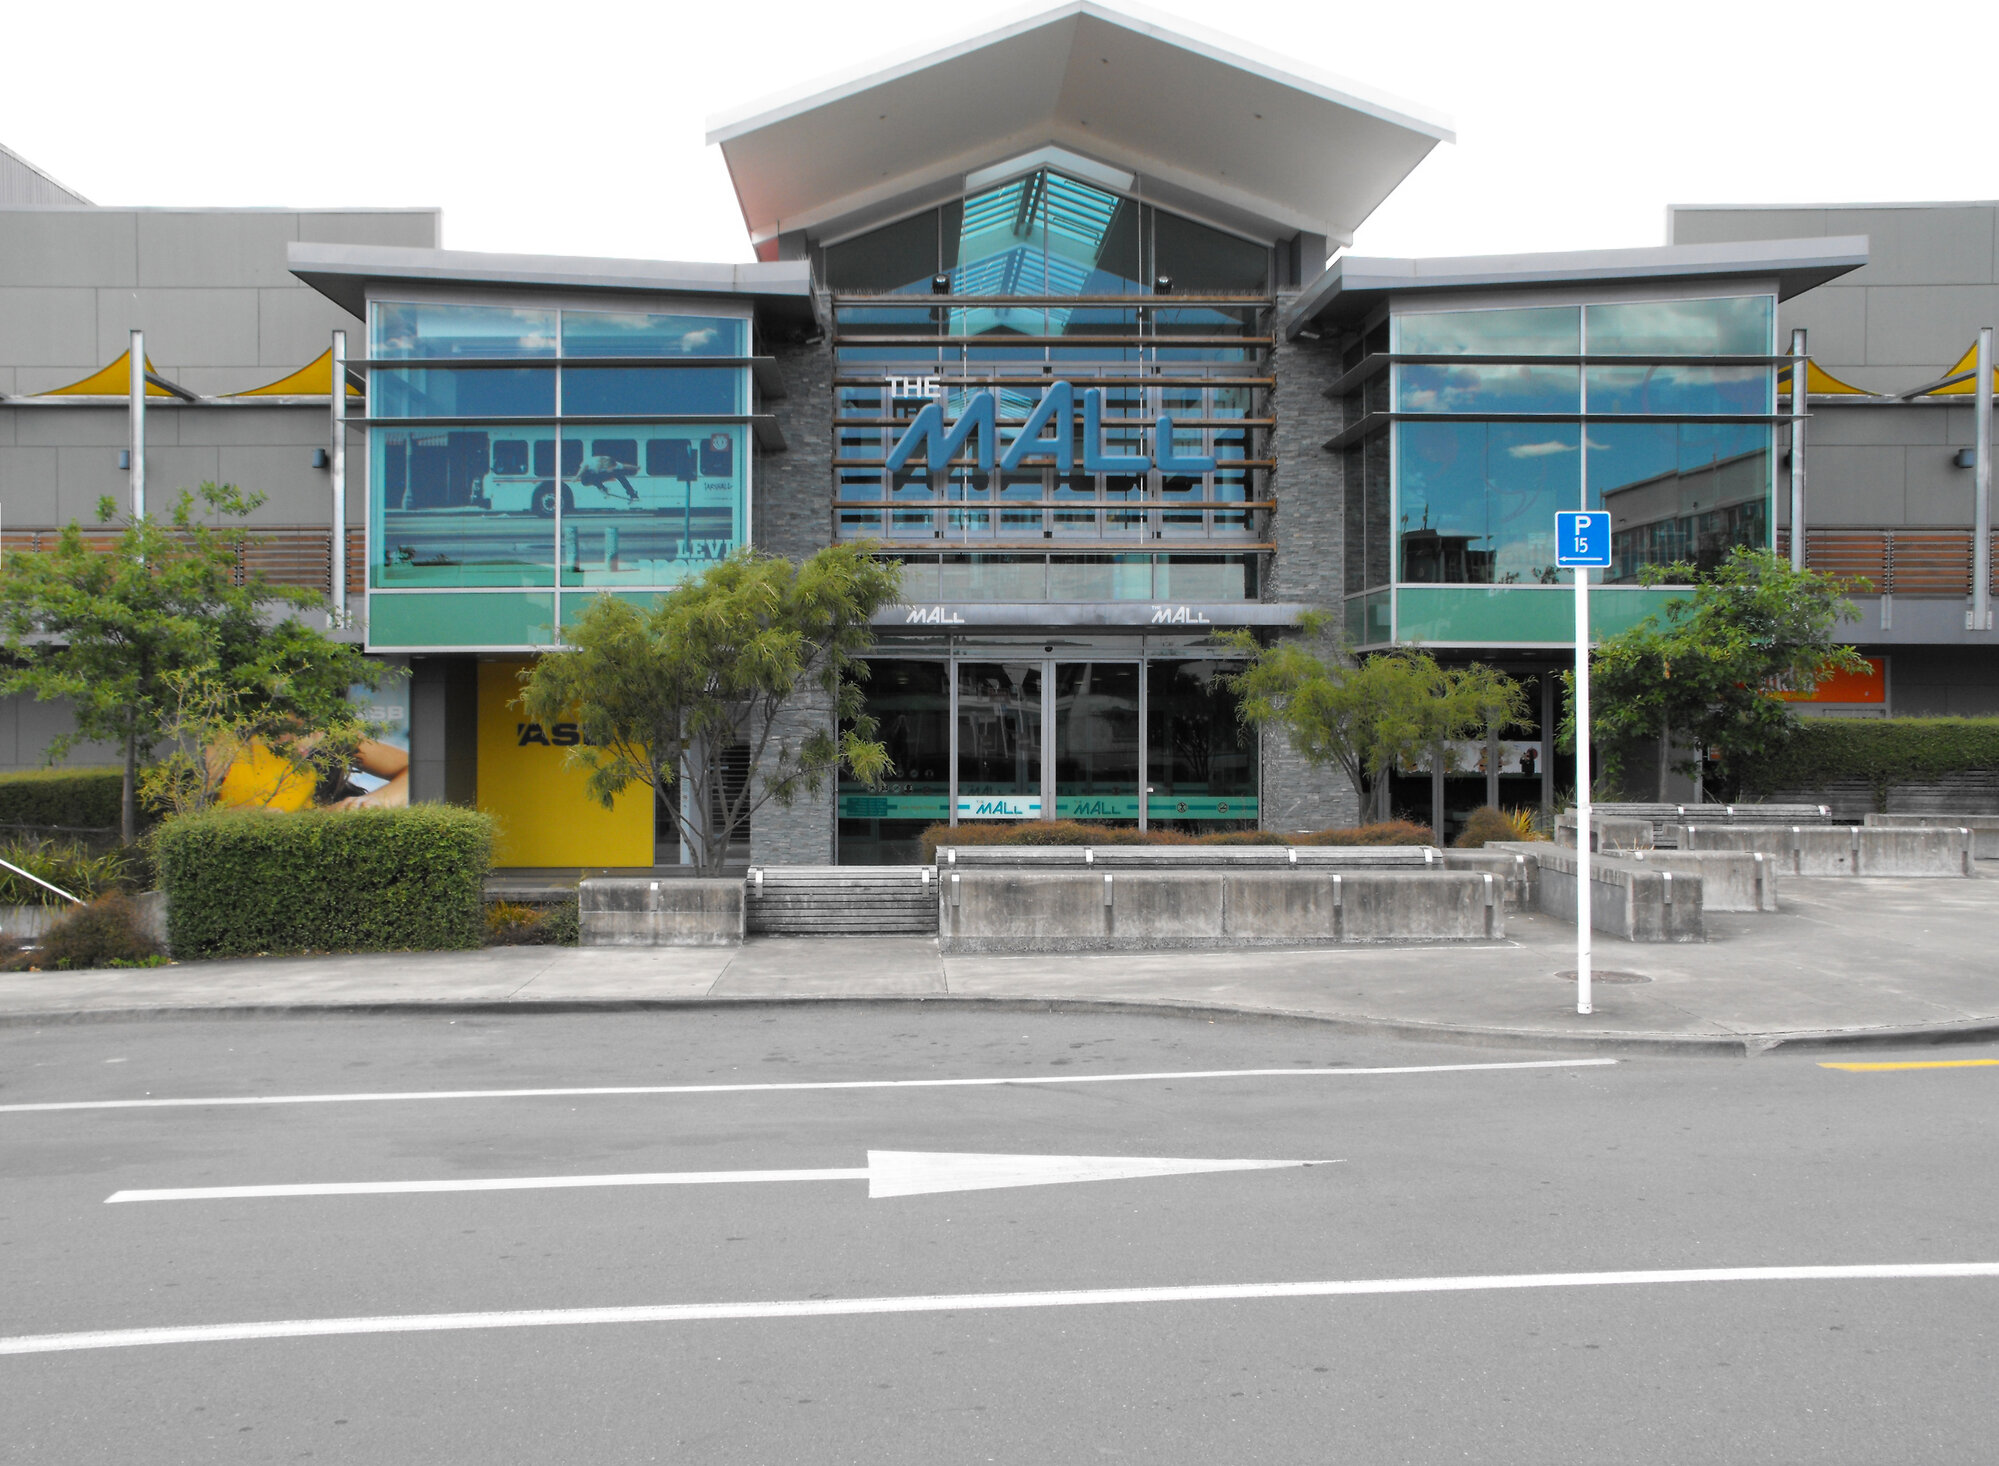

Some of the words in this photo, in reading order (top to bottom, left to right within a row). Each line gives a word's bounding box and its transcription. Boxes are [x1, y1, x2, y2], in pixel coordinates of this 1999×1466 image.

[886, 376, 941, 398] THE
[885, 380, 1217, 473] MALL
[1574, 515, 1592, 536] P
[1574, 536, 1589, 553] 15
[905, 606, 965, 624] MALL
[1151, 606, 1210, 624] MALL
[354, 705, 404, 720] SB
[975, 800, 1023, 815] MALL
[1073, 800, 1121, 815] MALL
